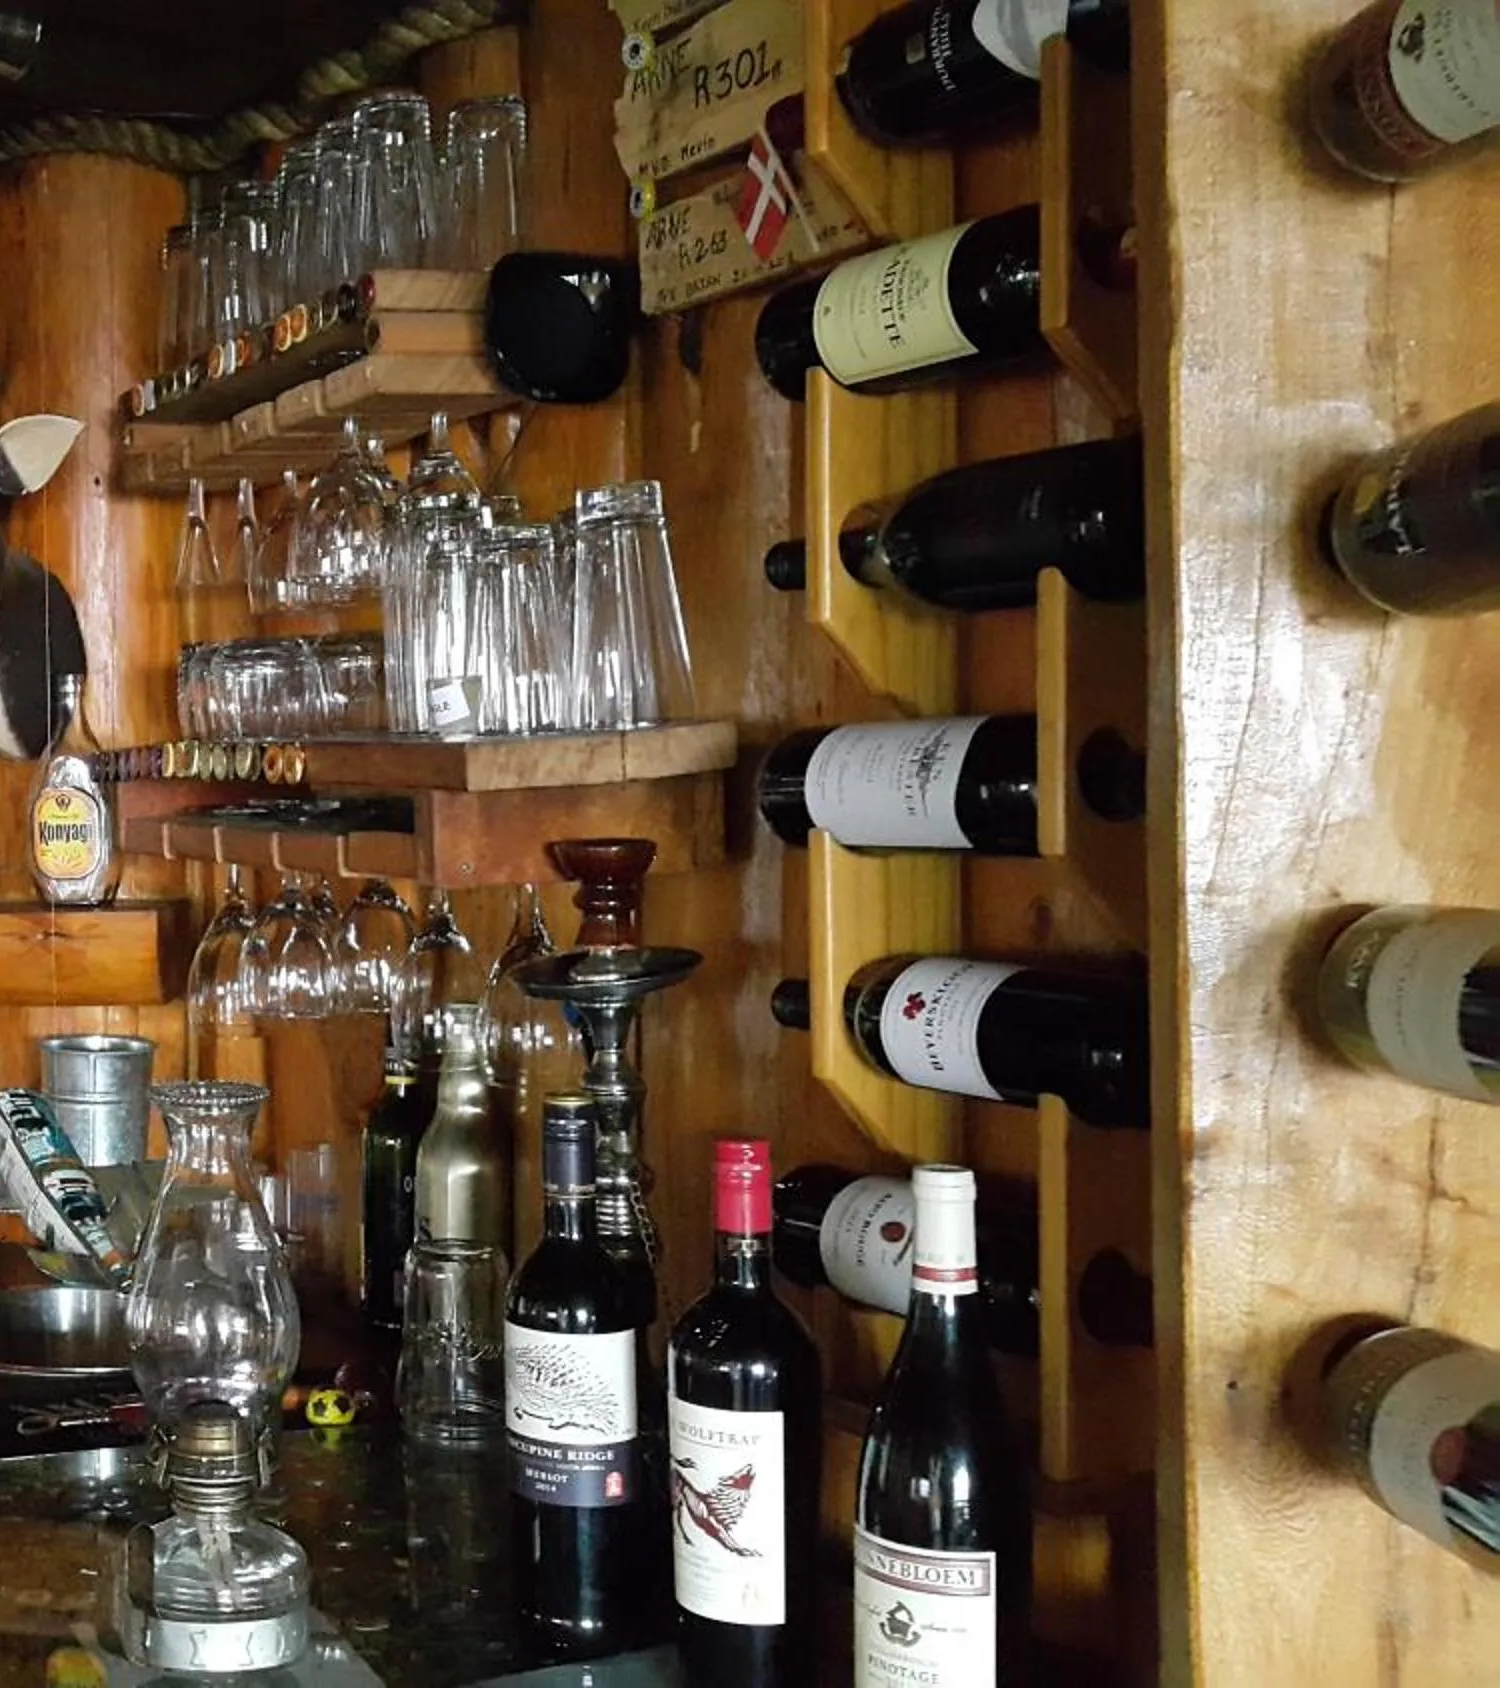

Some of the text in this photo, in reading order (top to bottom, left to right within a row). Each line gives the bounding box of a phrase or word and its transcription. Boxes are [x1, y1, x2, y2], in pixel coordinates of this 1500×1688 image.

[38, 820, 95, 847] Konyagi
[678, 1420, 762, 1446] WOLFTRAP
[567, 1449, 616, 1462] RIDGE
[524, 1467, 570, 1484] MERLOT
[867, 1652, 942, 1686] PINOTAGE
